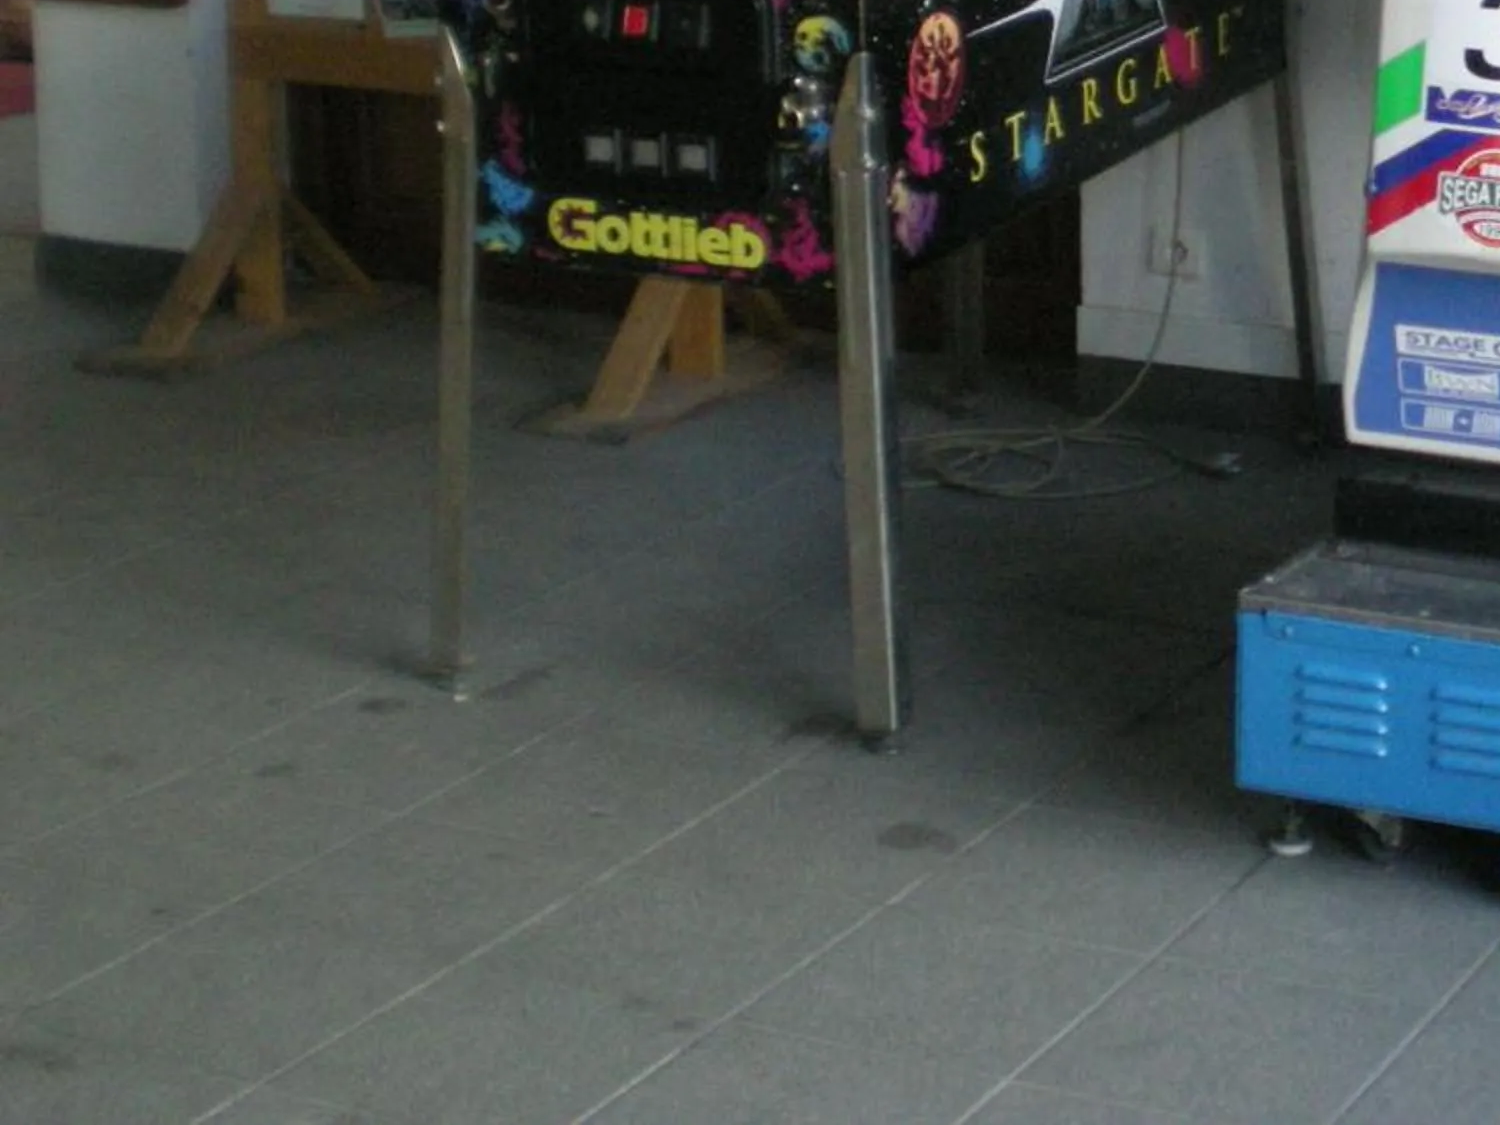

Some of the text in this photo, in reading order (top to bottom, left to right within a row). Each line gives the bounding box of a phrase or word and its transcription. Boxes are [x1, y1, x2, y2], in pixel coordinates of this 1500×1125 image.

[967, 13, 1232, 183] STARGATE
[1440, 175, 1491, 215] SEGA
[548, 197, 766, 269] Gottlieb
[1403, 330, 1487, 354] STAGE
